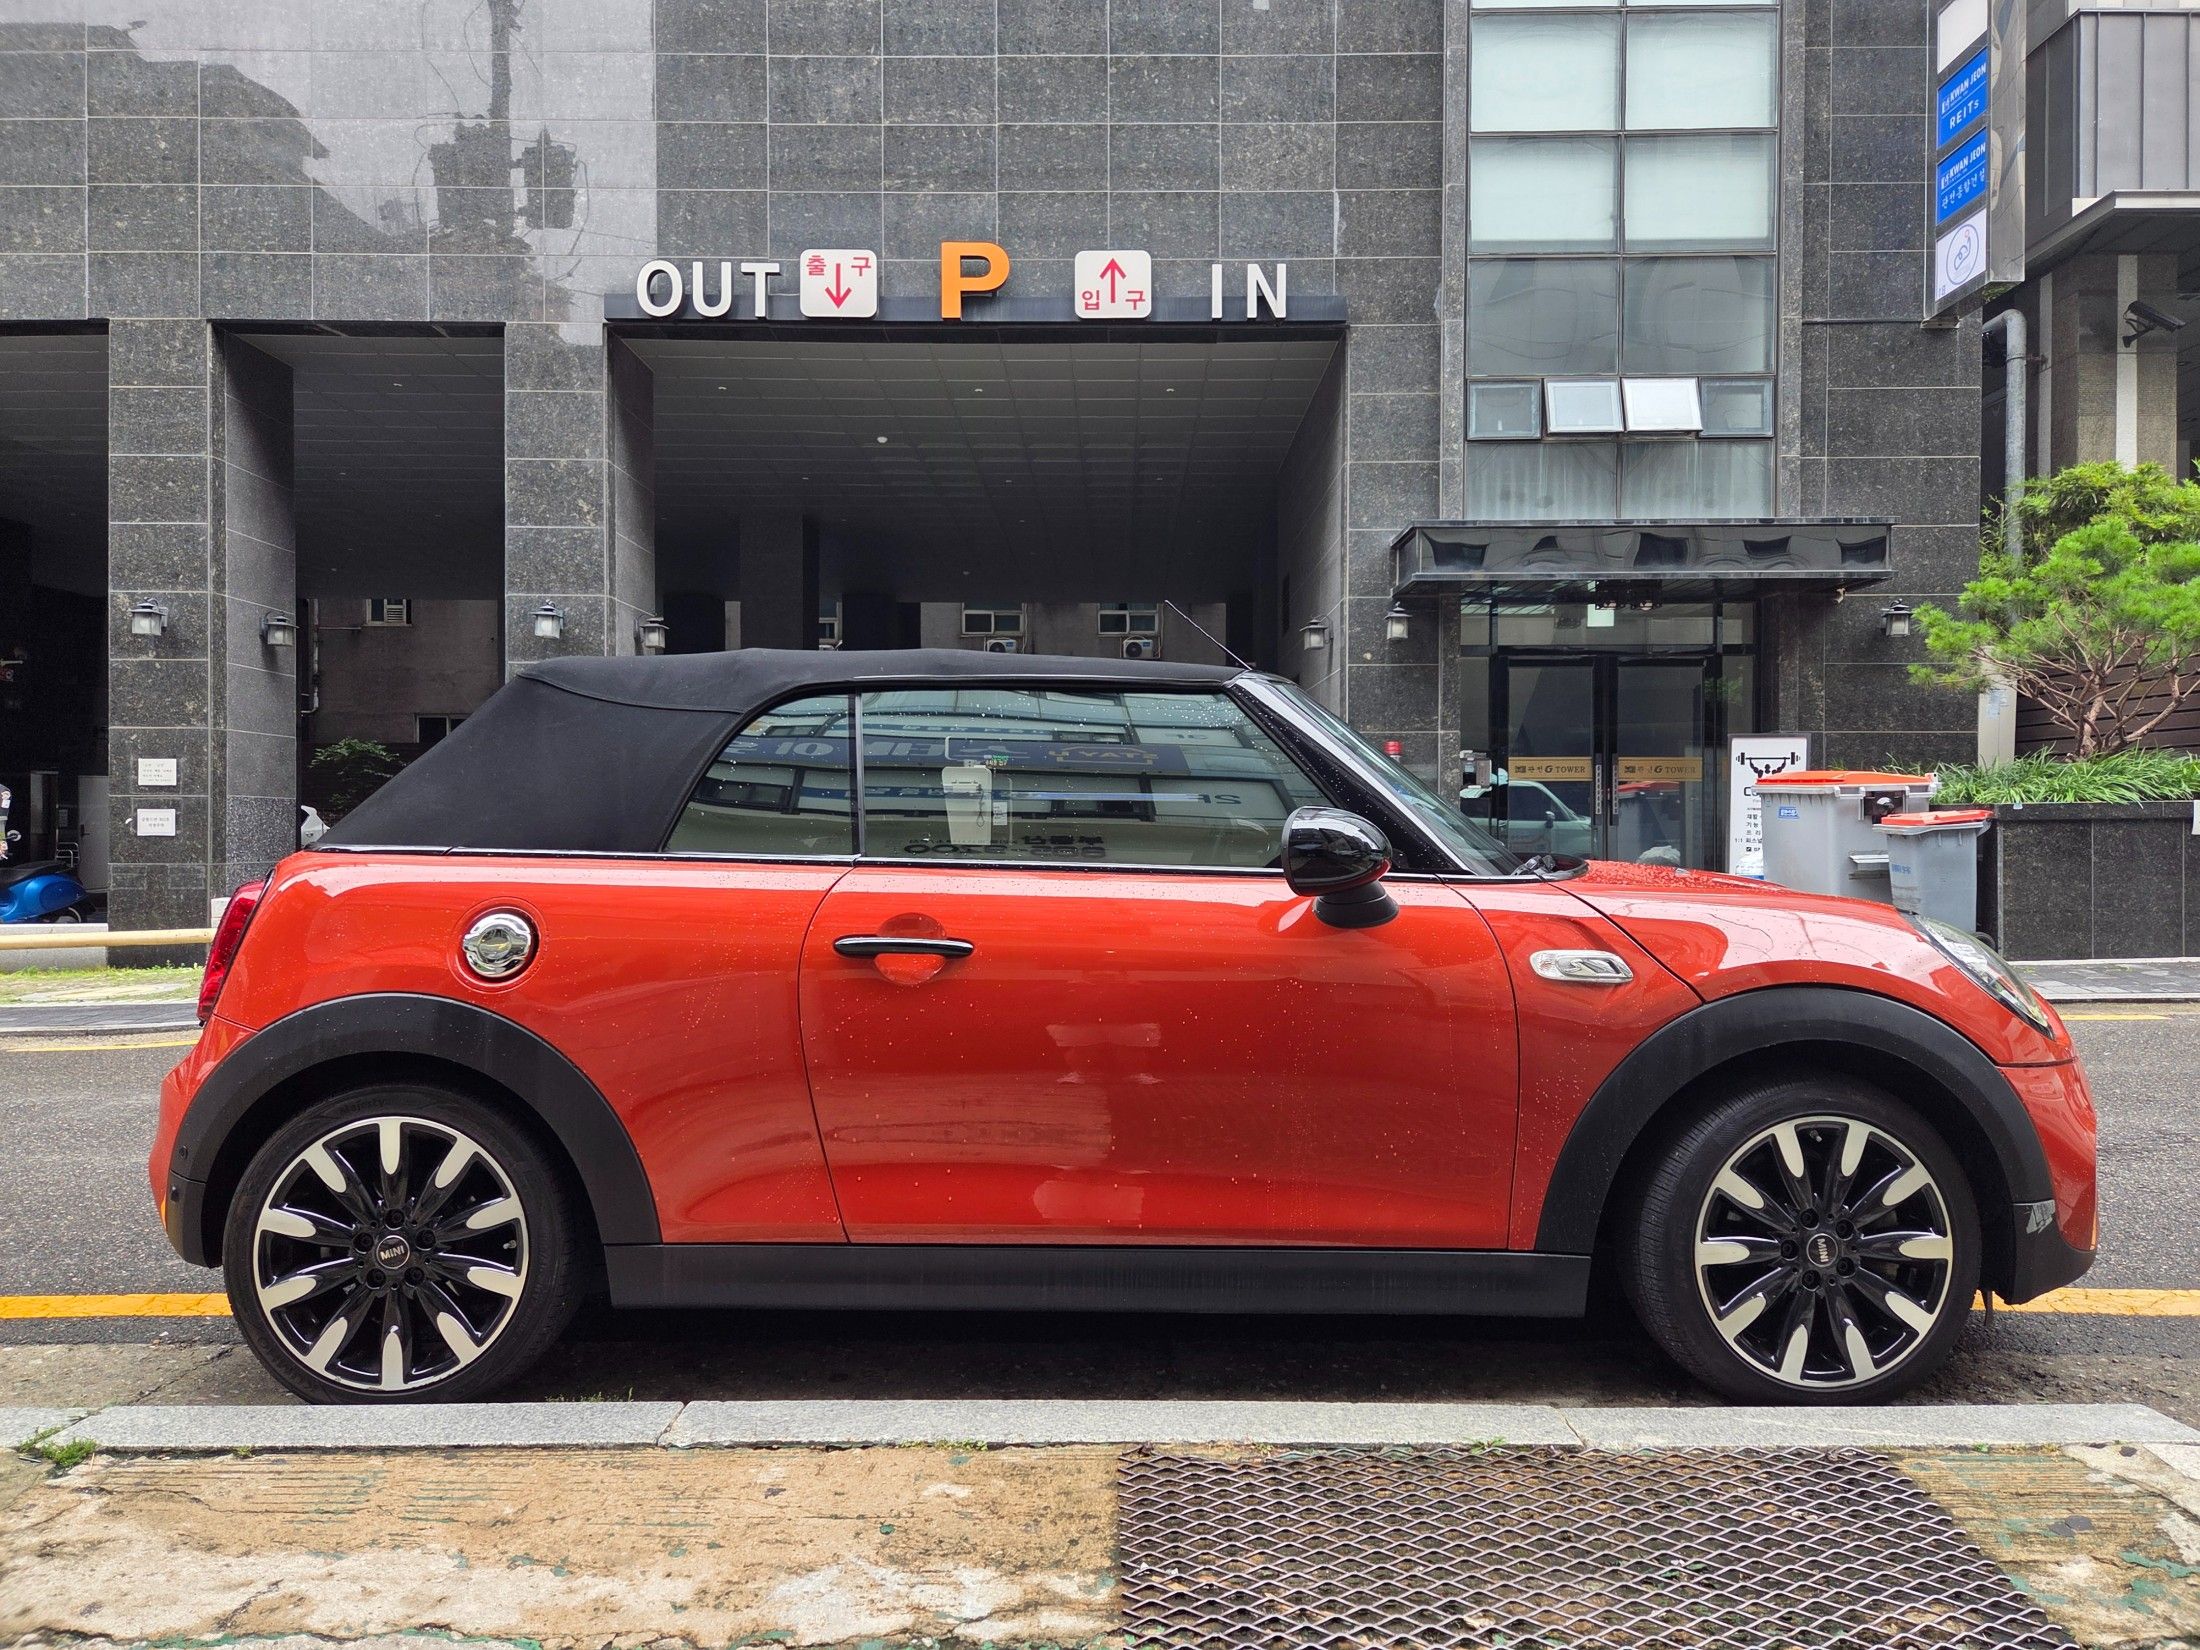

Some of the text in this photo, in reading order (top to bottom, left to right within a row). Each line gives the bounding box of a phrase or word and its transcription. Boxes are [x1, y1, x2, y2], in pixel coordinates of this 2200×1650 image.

[1950, 77, 1969, 101] KWAN
[1970, 62, 1987, 85] JEON
[1949, 155, 1969, 177] KWAN
[1969, 142, 1986, 164] JEON
[636, 259, 780, 318] OUT
[941, 241, 1010, 319] P
[1211, 263, 1287, 319] IN
[1544, 764, 1554, 774] G
[1555, 765, 1586, 774] TOWER
[1665, 765, 1696, 774] TOWER
[380, 1245, 405, 1261] MINI
[1816, 1238, 1829, 1263] MINI
